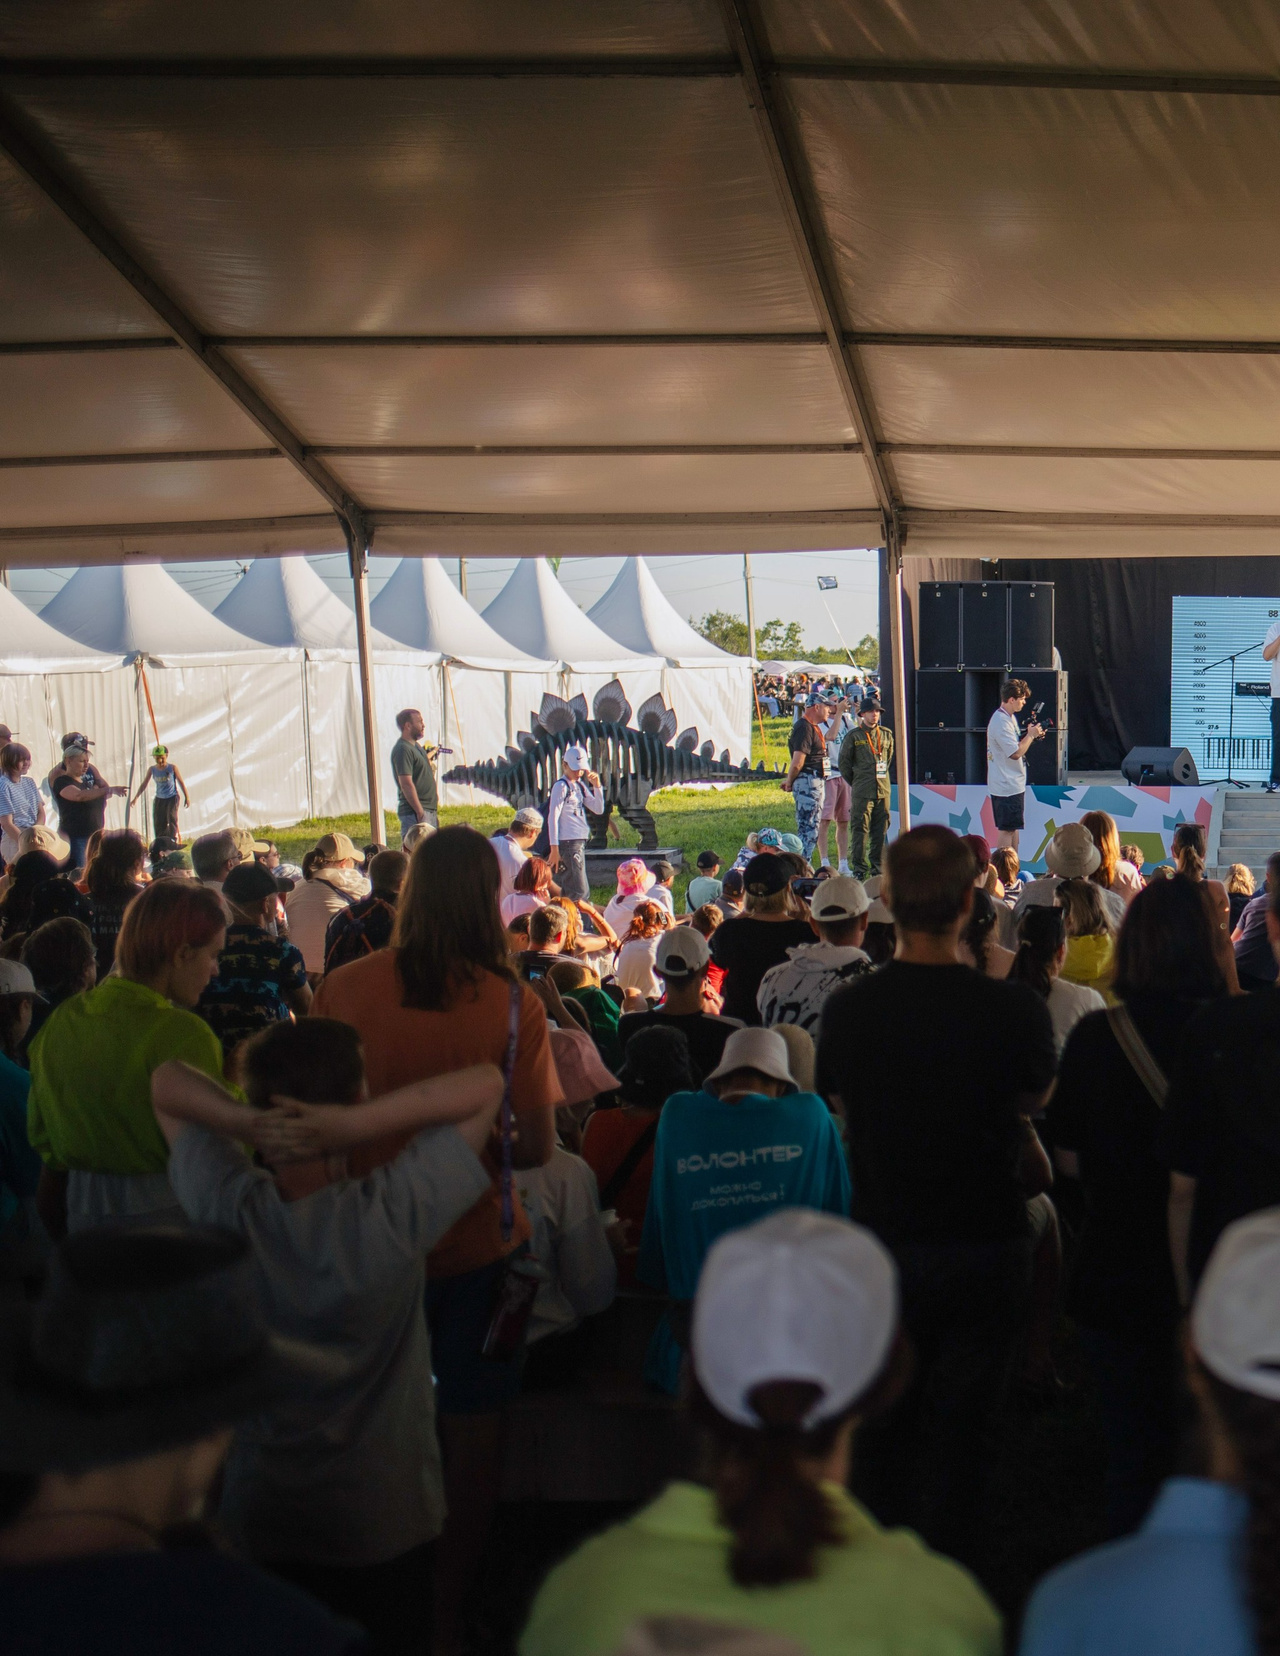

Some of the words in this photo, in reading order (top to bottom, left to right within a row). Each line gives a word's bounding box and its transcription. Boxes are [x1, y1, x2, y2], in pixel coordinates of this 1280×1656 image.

[1268, 610, 1279, 618] 88
[676, 1144, 803, 1174] ВОЛОНТЕР
[709, 1181, 762, 1195] МОЖНО
